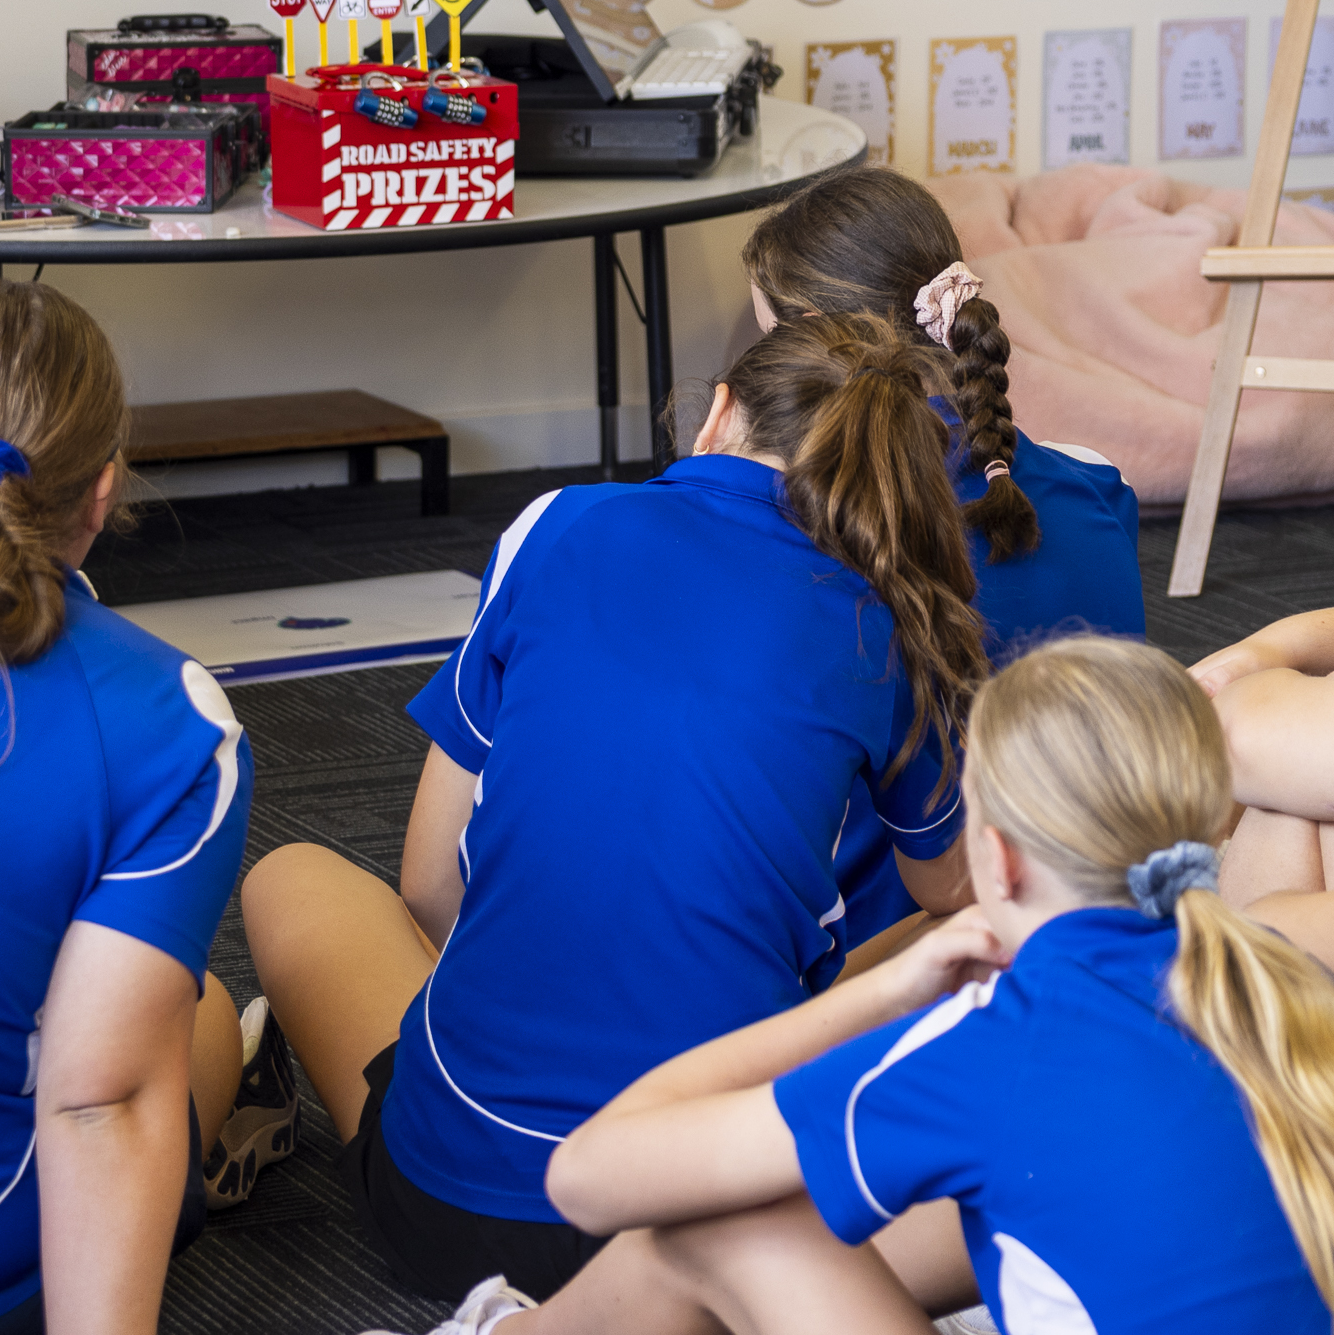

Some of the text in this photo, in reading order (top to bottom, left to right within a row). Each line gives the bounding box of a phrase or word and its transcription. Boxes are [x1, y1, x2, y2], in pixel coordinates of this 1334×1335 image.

[373, 7, 397, 16] ENTRY
[341, 137, 497, 167] ROAD SAFETY
[341, 165, 496, 208] PRIZES
